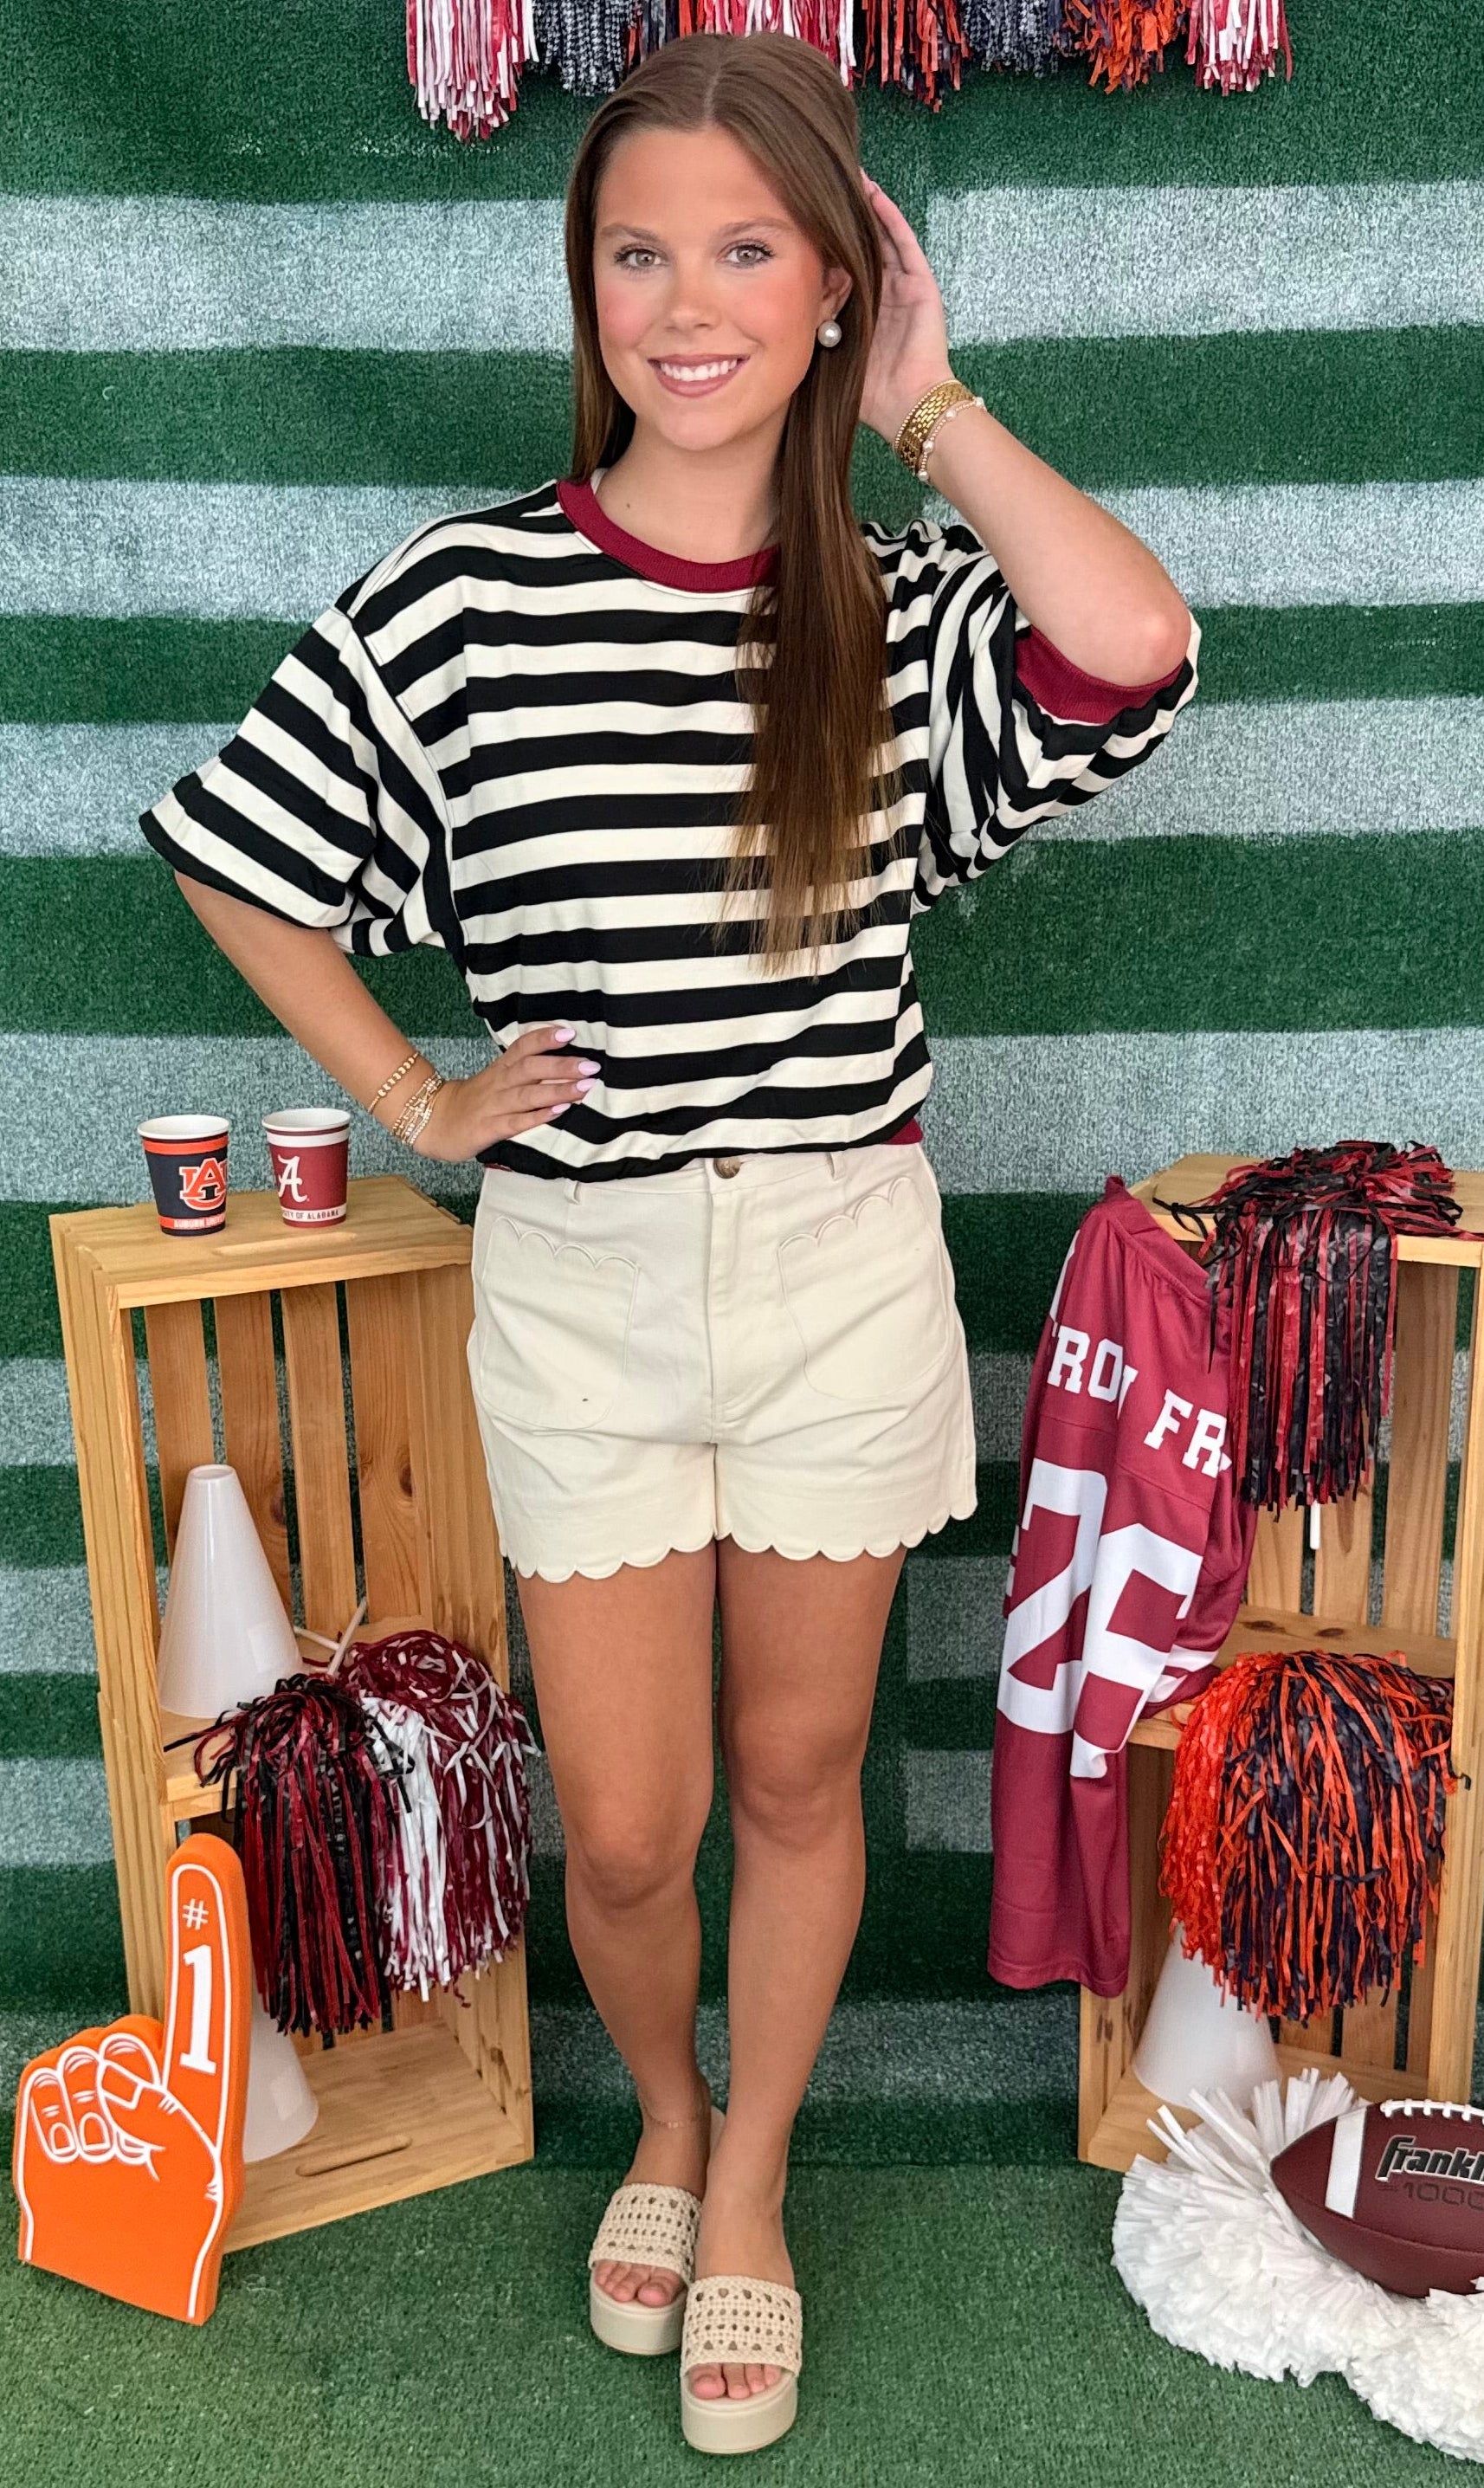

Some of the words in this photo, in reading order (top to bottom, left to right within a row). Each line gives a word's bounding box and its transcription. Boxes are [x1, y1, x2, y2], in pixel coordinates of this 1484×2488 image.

[278, 1154, 307, 1202] A
[307, 1209, 339, 1220] ALABAMA
[1143, 1388, 1232, 1478] FR
[1375, 2134, 1484, 2186] Frankl
